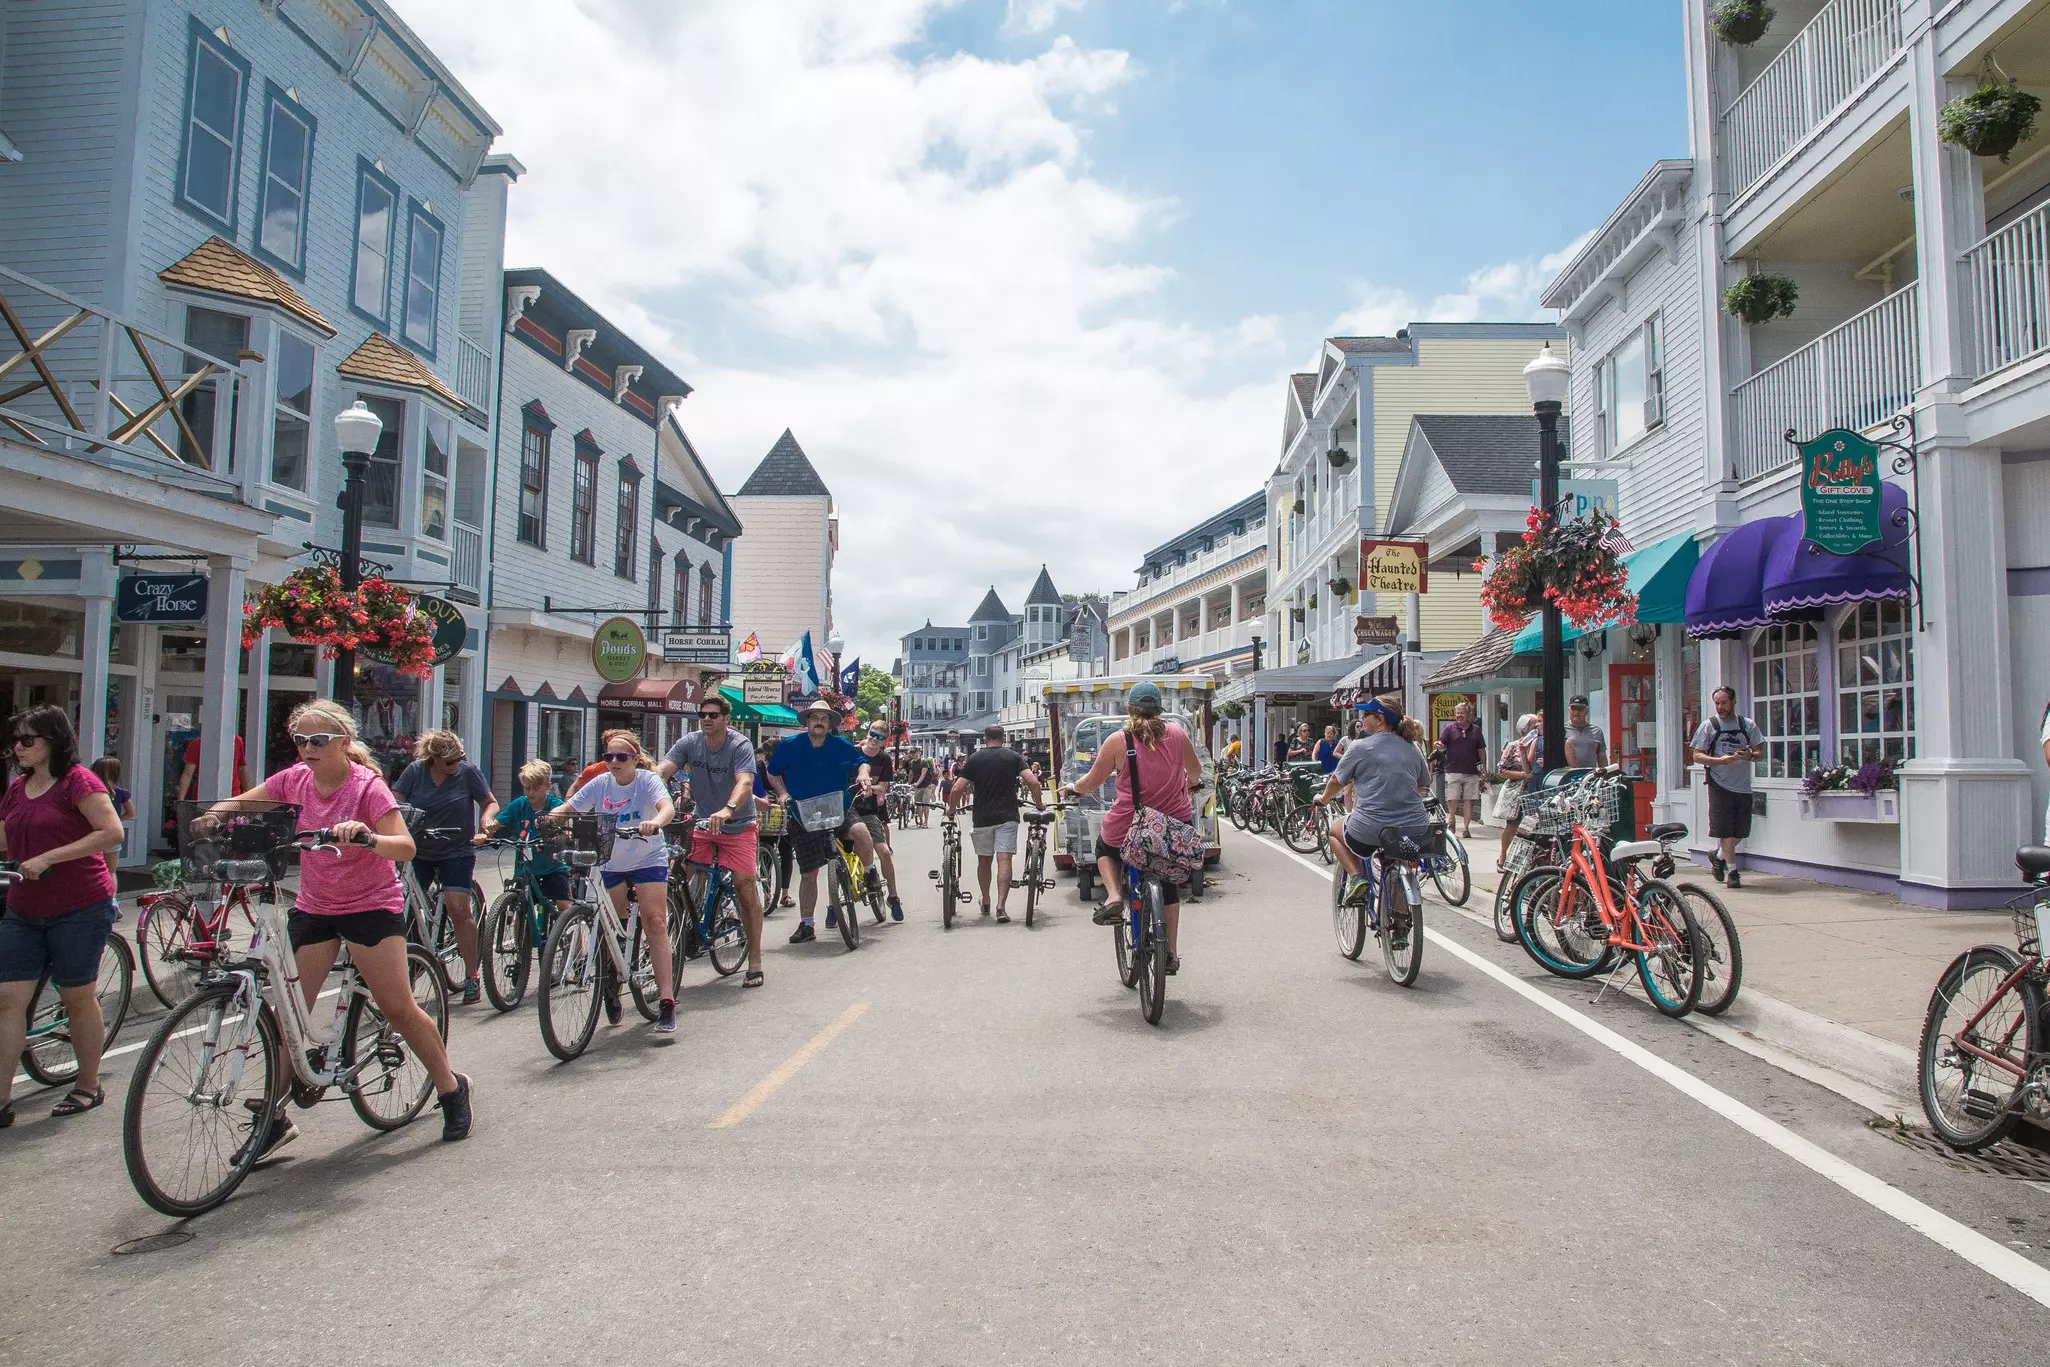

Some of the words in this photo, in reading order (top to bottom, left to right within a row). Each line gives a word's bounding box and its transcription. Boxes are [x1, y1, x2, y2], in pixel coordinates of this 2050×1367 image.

[1808, 451, 1873, 489] Betty's
[1820, 486, 1840, 494] GIFT
[1843, 486, 1868, 494] COVE
[1386, 547, 1400, 557] The
[1368, 556, 1417, 575] Haunted
[135, 580, 175, 599] Crazy
[1369, 574, 1417, 590] Theatre
[156, 595, 197, 611] Horse
[428, 599, 461, 624] OUT
[1356, 629, 1396, 637] CHUCKWAGON
[363, 648, 376, 659] THE
[601, 640, 637, 656] Doud's
[622, 700, 645, 708] CORRAL
[668, 700, 682, 711] HORSE
[682, 701, 697, 713] CORRAL
